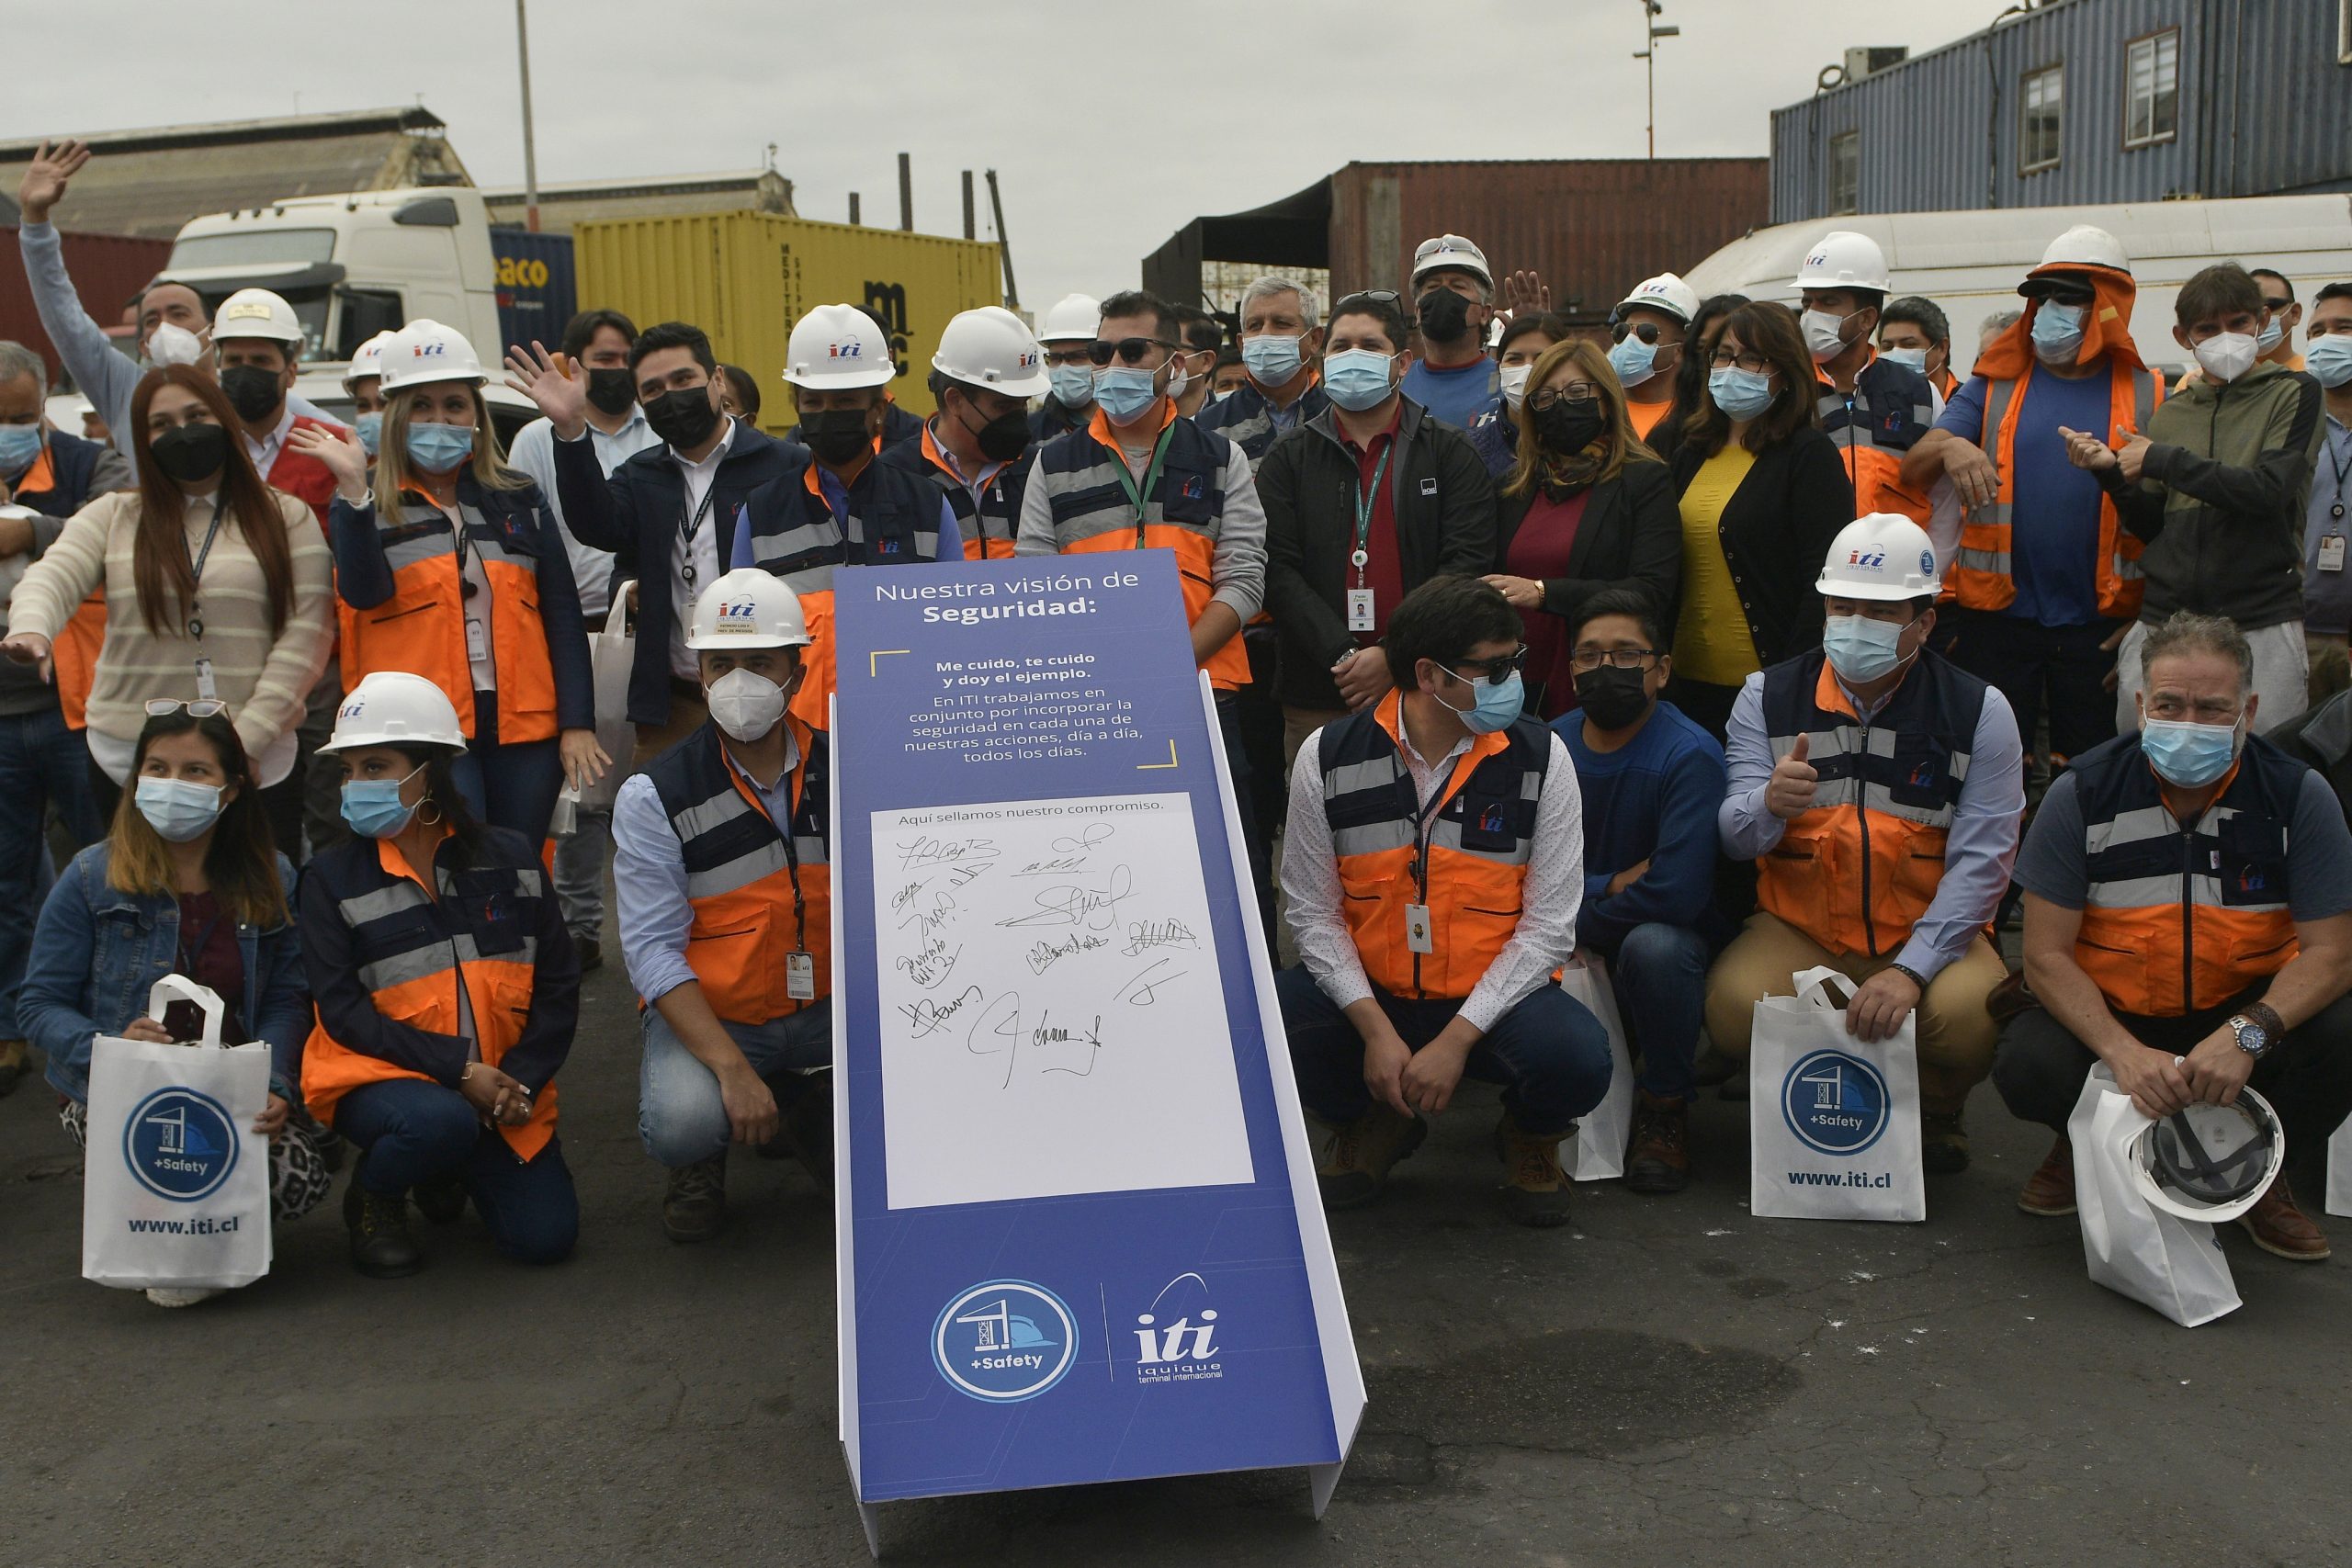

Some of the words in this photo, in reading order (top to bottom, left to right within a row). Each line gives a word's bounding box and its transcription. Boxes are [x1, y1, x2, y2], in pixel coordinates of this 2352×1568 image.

[413, 343, 446, 357] iti
[829, 343, 862, 357] iti
[1019, 350, 1038, 367] iti
[1847, 549, 1885, 568] iti
[876, 581, 996, 602] Nuestra
[1003, 574, 1092, 594] visión
[1102, 570, 1139, 588] de
[718, 603, 755, 617] iti
[923, 597, 1097, 625] Seguridad:
[936, 661, 963, 672] Me
[967, 658, 1021, 670] cuido,
[1024, 657, 1043, 667] te
[1047, 653, 1095, 665] cuido
[943, 677, 954, 688] y
[957, 673, 990, 686] doy
[994, 672, 1011, 682] el
[1015, 668, 1091, 683] ejemplo.
[933, 696, 954, 707] En
[959, 694, 978, 705] ITI
[984, 689, 1080, 705] trabajamos
[1084, 687, 1105, 698] en
[339, 702, 366, 718] iti
[909, 707, 984, 724] conjunto
[989, 707, 1019, 721] por
[1023, 701, 1113, 716] incorporar
[1117, 699, 1132, 710] la
[912, 722, 997, 738] seguridad
[1002, 720, 1023, 731] en
[1029, 716, 1069, 729] cada
[1074, 716, 1105, 727] una
[1111, 714, 1132, 725] de
[904, 738, 979, 752] nuestras
[984, 733, 1062, 748] acciones,
[1067, 730, 1092, 741] día
[1098, 731, 1108, 740] a
[1113, 728, 1144, 739] día,
[964, 750, 1013, 763] todos
[1018, 748, 1043, 760] los
[1047, 746, 1087, 758] días.
[899, 813, 933, 827] Aquí
[936, 809, 1002, 823] sellamos
[1006, 806, 1063, 818] nuestro
[1067, 799, 1165, 817] compromiso.
[1810, 1114, 1863, 1131] +Safety
[154, 1157, 209, 1177] +Safety
[1788, 1171, 1891, 1189] www.iti.cl
[129, 1216, 239, 1235] www.iti.cl
[1134, 1309, 1220, 1364] iti
[970, 1353, 1044, 1371] +Safety
[1137, 1362, 1221, 1377] iquique
[1138, 1372, 1170, 1384] terminal
[1172, 1370, 1223, 1382] internacional
